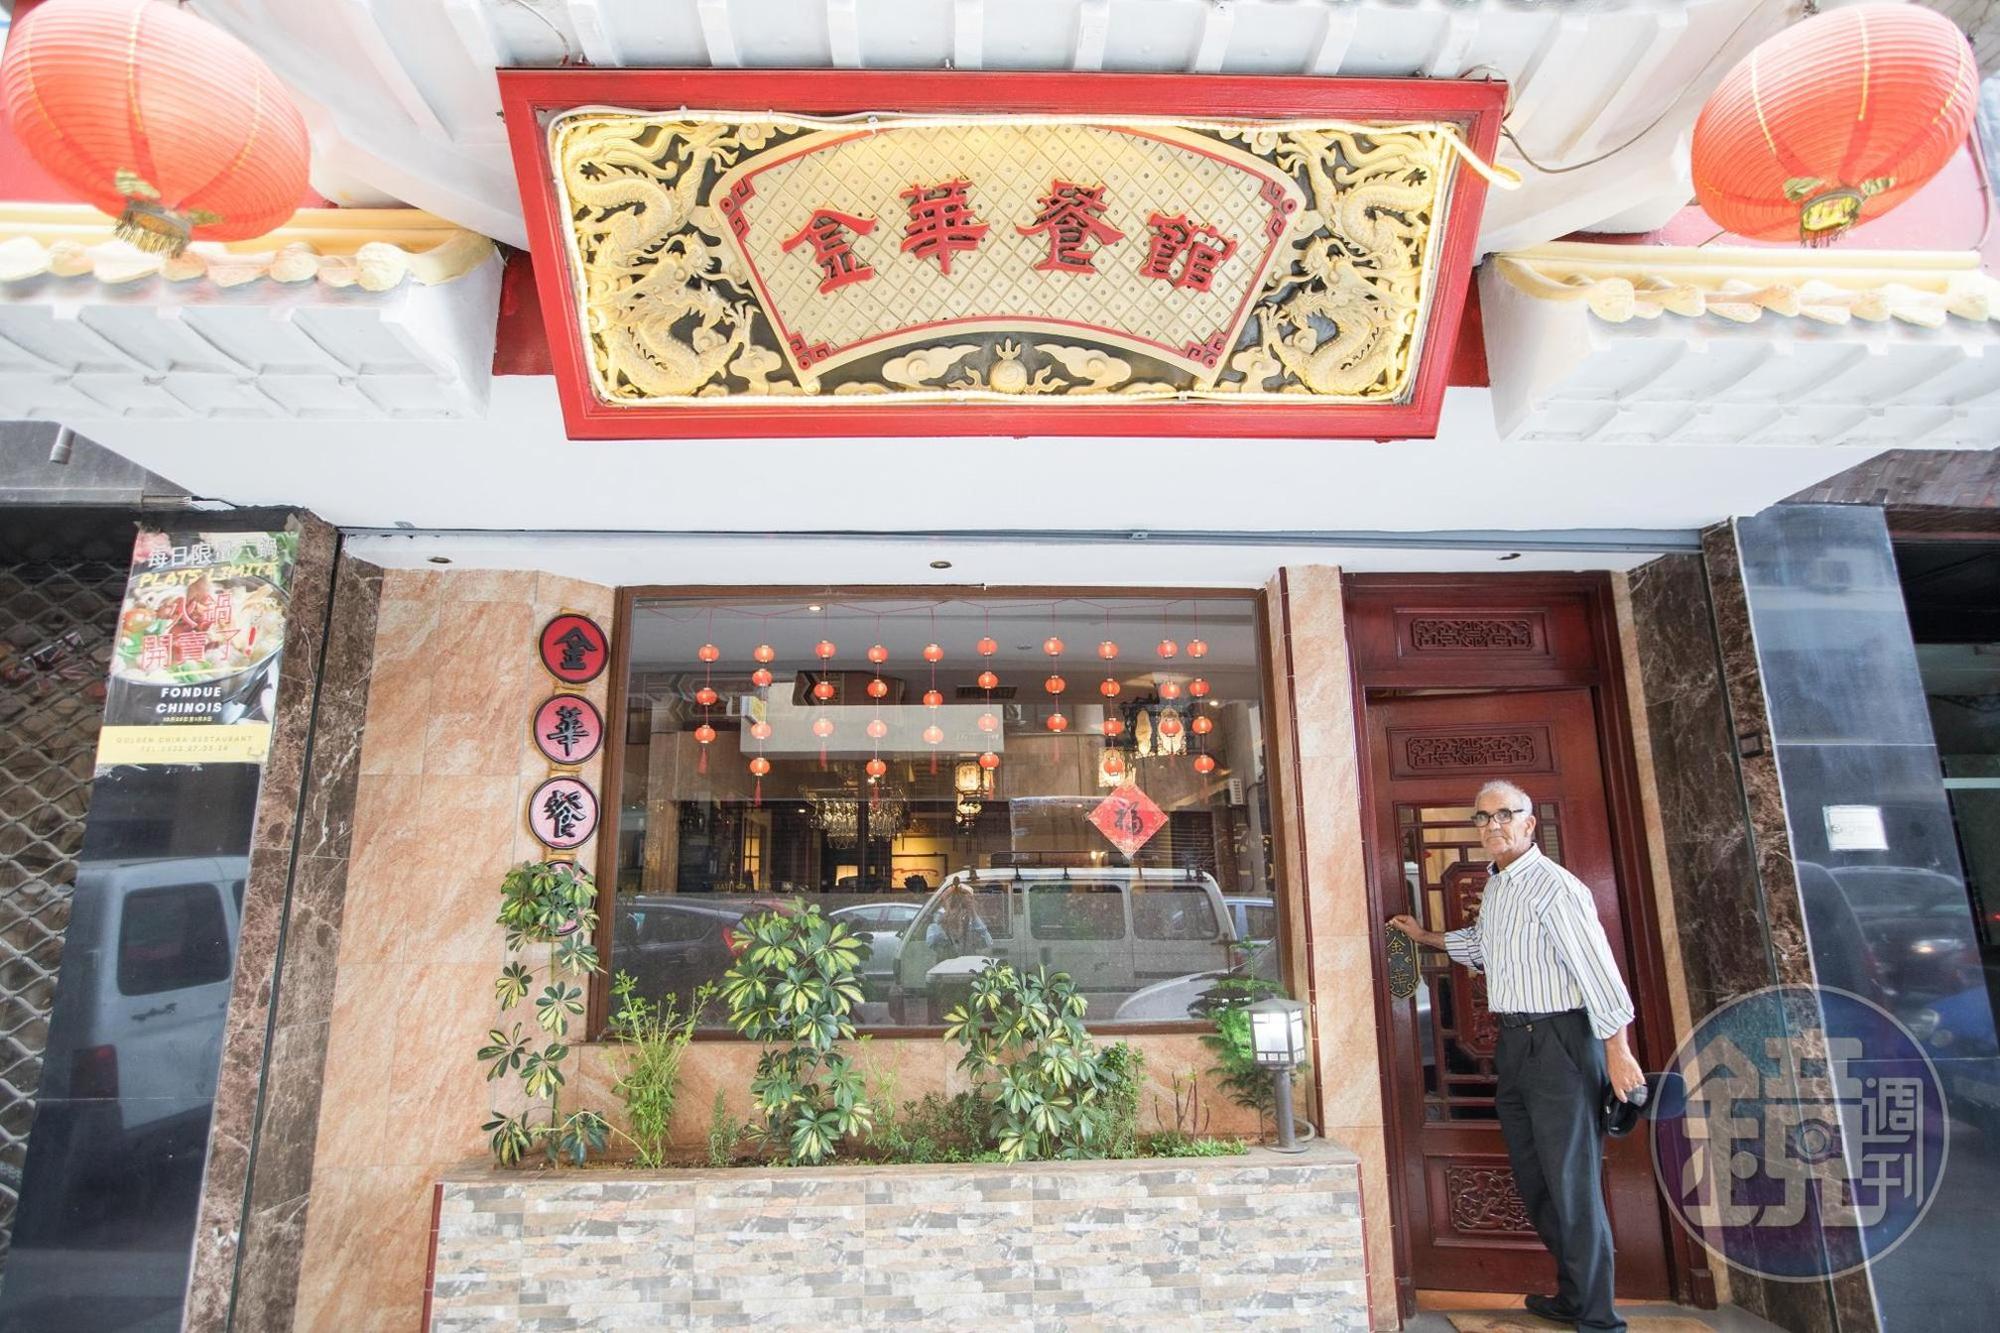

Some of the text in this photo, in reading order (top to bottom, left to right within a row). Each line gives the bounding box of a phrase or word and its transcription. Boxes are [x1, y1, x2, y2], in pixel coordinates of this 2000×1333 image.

[782, 177, 1238, 294] 金華餐館
[165, 592, 232, 633] 火鍋
[156, 702, 222, 714] CHINOIS
[160, 687, 222, 698] FONDUE
[544, 626, 598, 900] 金華餐
[1115, 799, 1143, 835] 福
